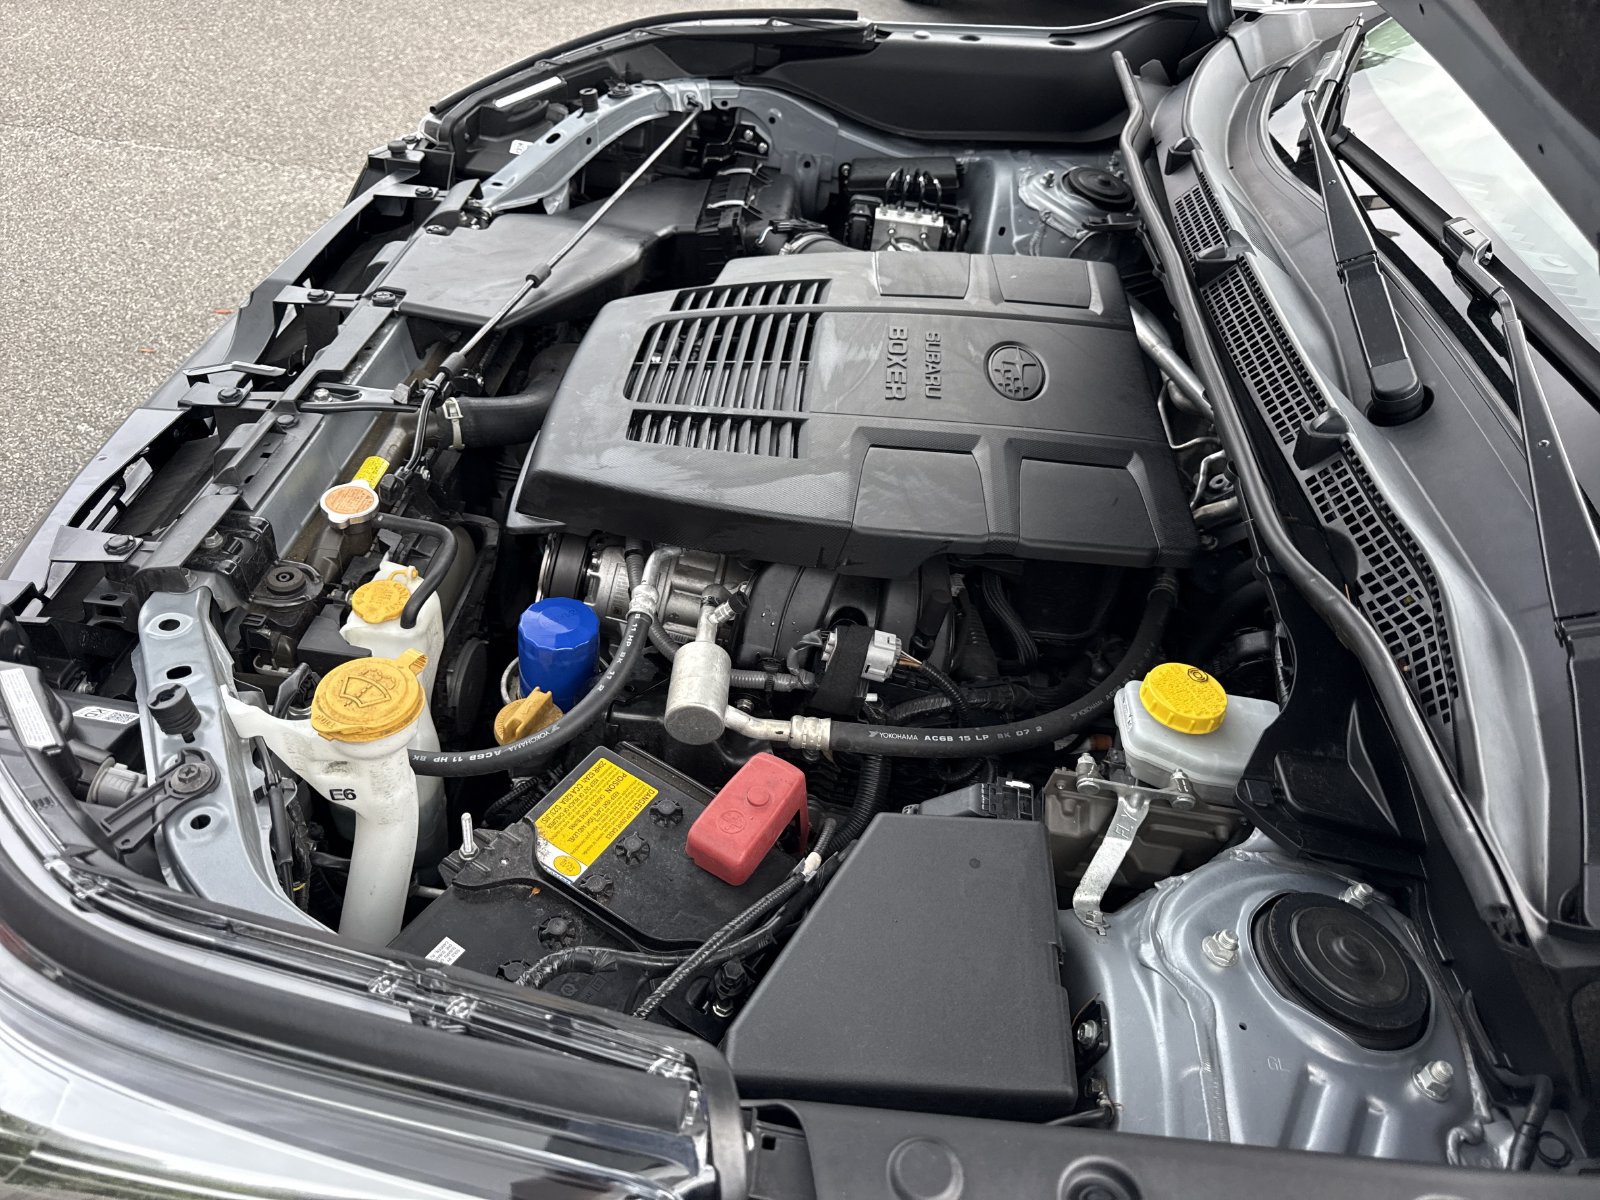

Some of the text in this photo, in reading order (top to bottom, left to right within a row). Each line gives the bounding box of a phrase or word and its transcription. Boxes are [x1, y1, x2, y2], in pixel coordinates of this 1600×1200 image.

[885, 326, 908, 400] BOXER
[925, 332, 941, 399] SUBARU
[625, 634, 634, 647] HP
[508, 731, 549, 751] YOKOHAMA
[879, 732, 918, 741] YOKOHAMA
[604, 773, 627, 793] POISON
[329, 788, 356, 800] E6
[632, 789, 654, 810] DANGER
